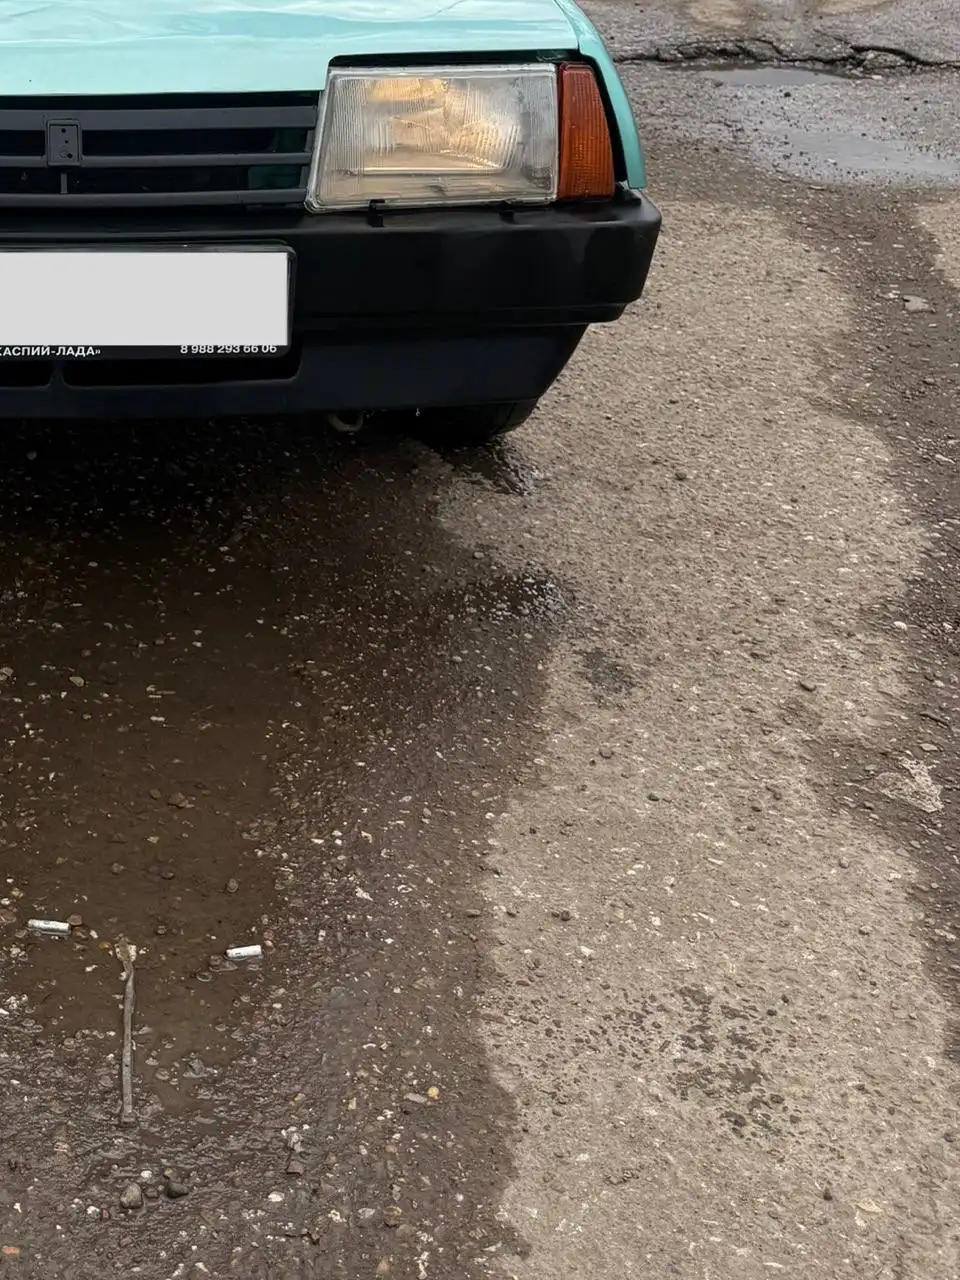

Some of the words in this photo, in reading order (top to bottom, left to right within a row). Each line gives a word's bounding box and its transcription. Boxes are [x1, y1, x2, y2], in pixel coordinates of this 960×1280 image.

[180, 345, 188, 354] 8
[191, 345, 214, 354] 988
[217, 345, 240, 354] 293
[243, 345, 258, 353] 66
[261, 345, 277, 353] 06
